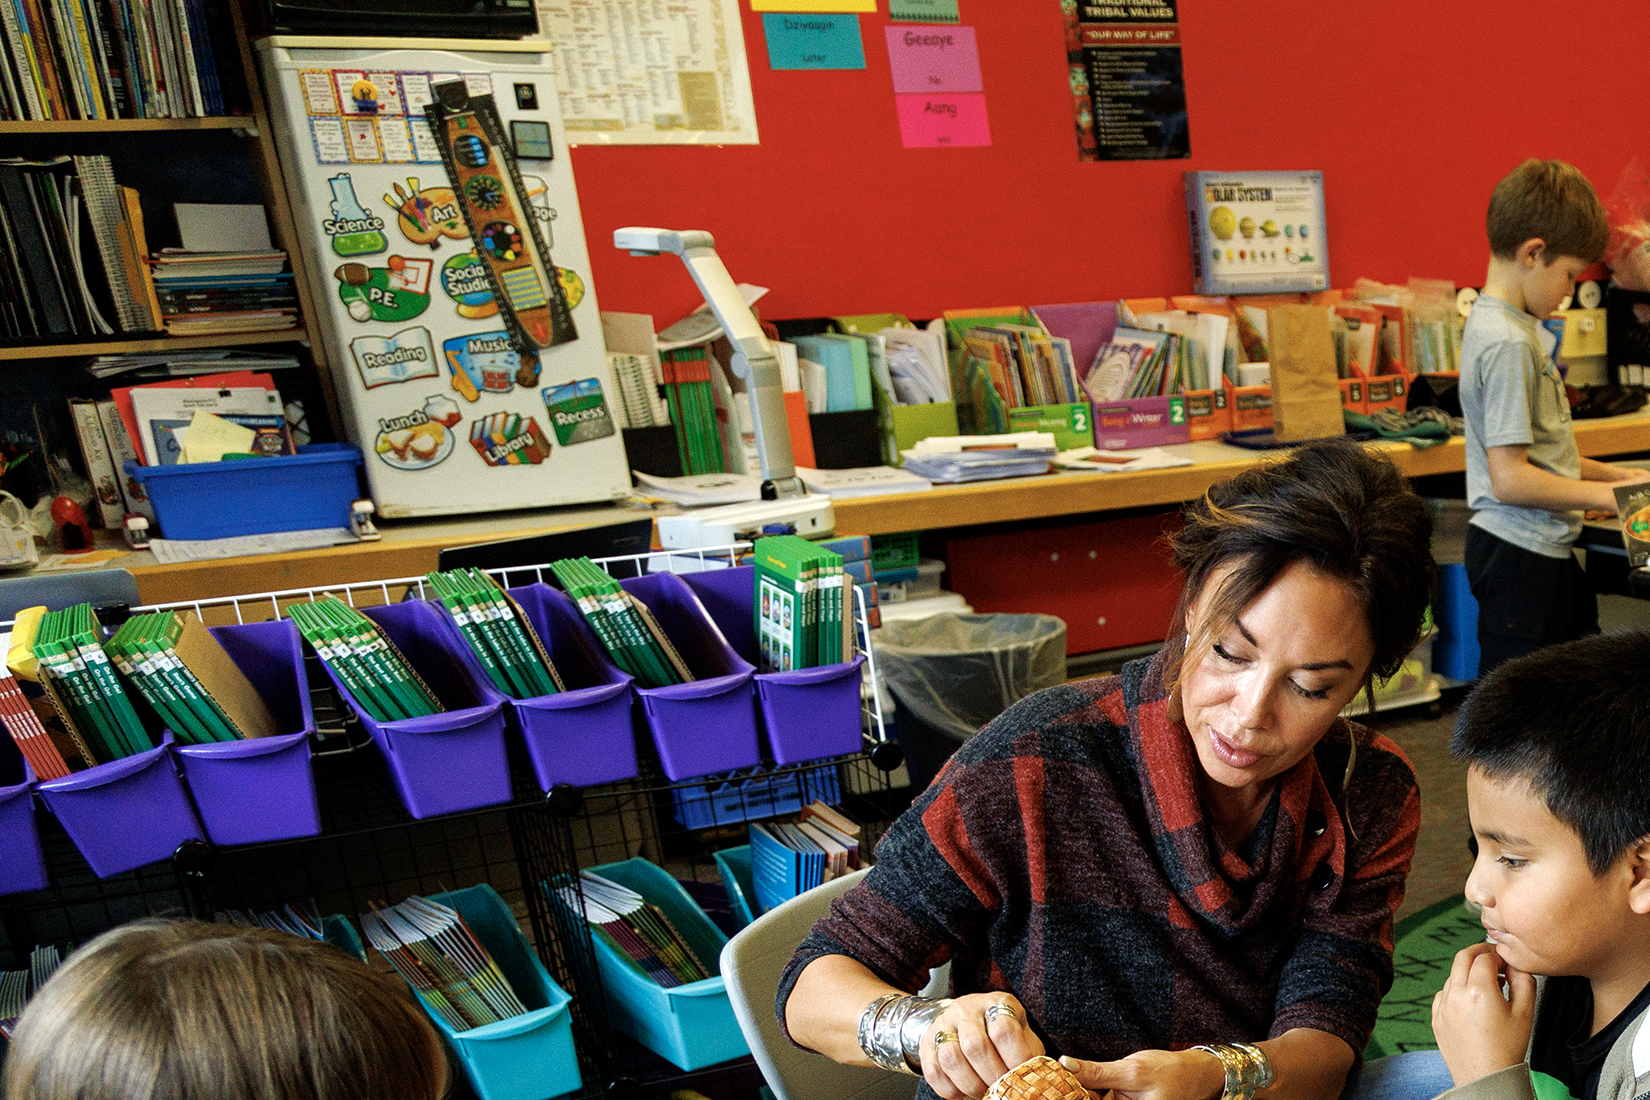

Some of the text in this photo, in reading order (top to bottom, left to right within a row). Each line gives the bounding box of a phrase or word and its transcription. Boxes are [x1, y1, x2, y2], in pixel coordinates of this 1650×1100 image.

[1084, 7, 1174, 18] TRIBAL VALUES
[1113, 31, 1132, 39] WAY
[1136, 31, 1148, 39] OF
[1238, 187, 1273, 201] SYSTEM
[431, 206, 459, 223] Art
[323, 216, 386, 236] Science
[444, 265, 487, 281] Socia
[447, 279, 494, 297] Studie
[368, 287, 400, 309] P.E.
[467, 337, 513, 354] Music
[363, 346, 428, 369] Reading
[379, 410, 429, 433] Lunch
[554, 408, 605, 426] Recess
[1074, 414, 1086, 431] 2
[1173, 406, 1184, 423] 2
[483, 431, 536, 462] Library
[82, 672, 89, 681] On
[94, 668, 101, 677] On
[103, 666, 111, 675] On
[72, 676, 80, 685] On
